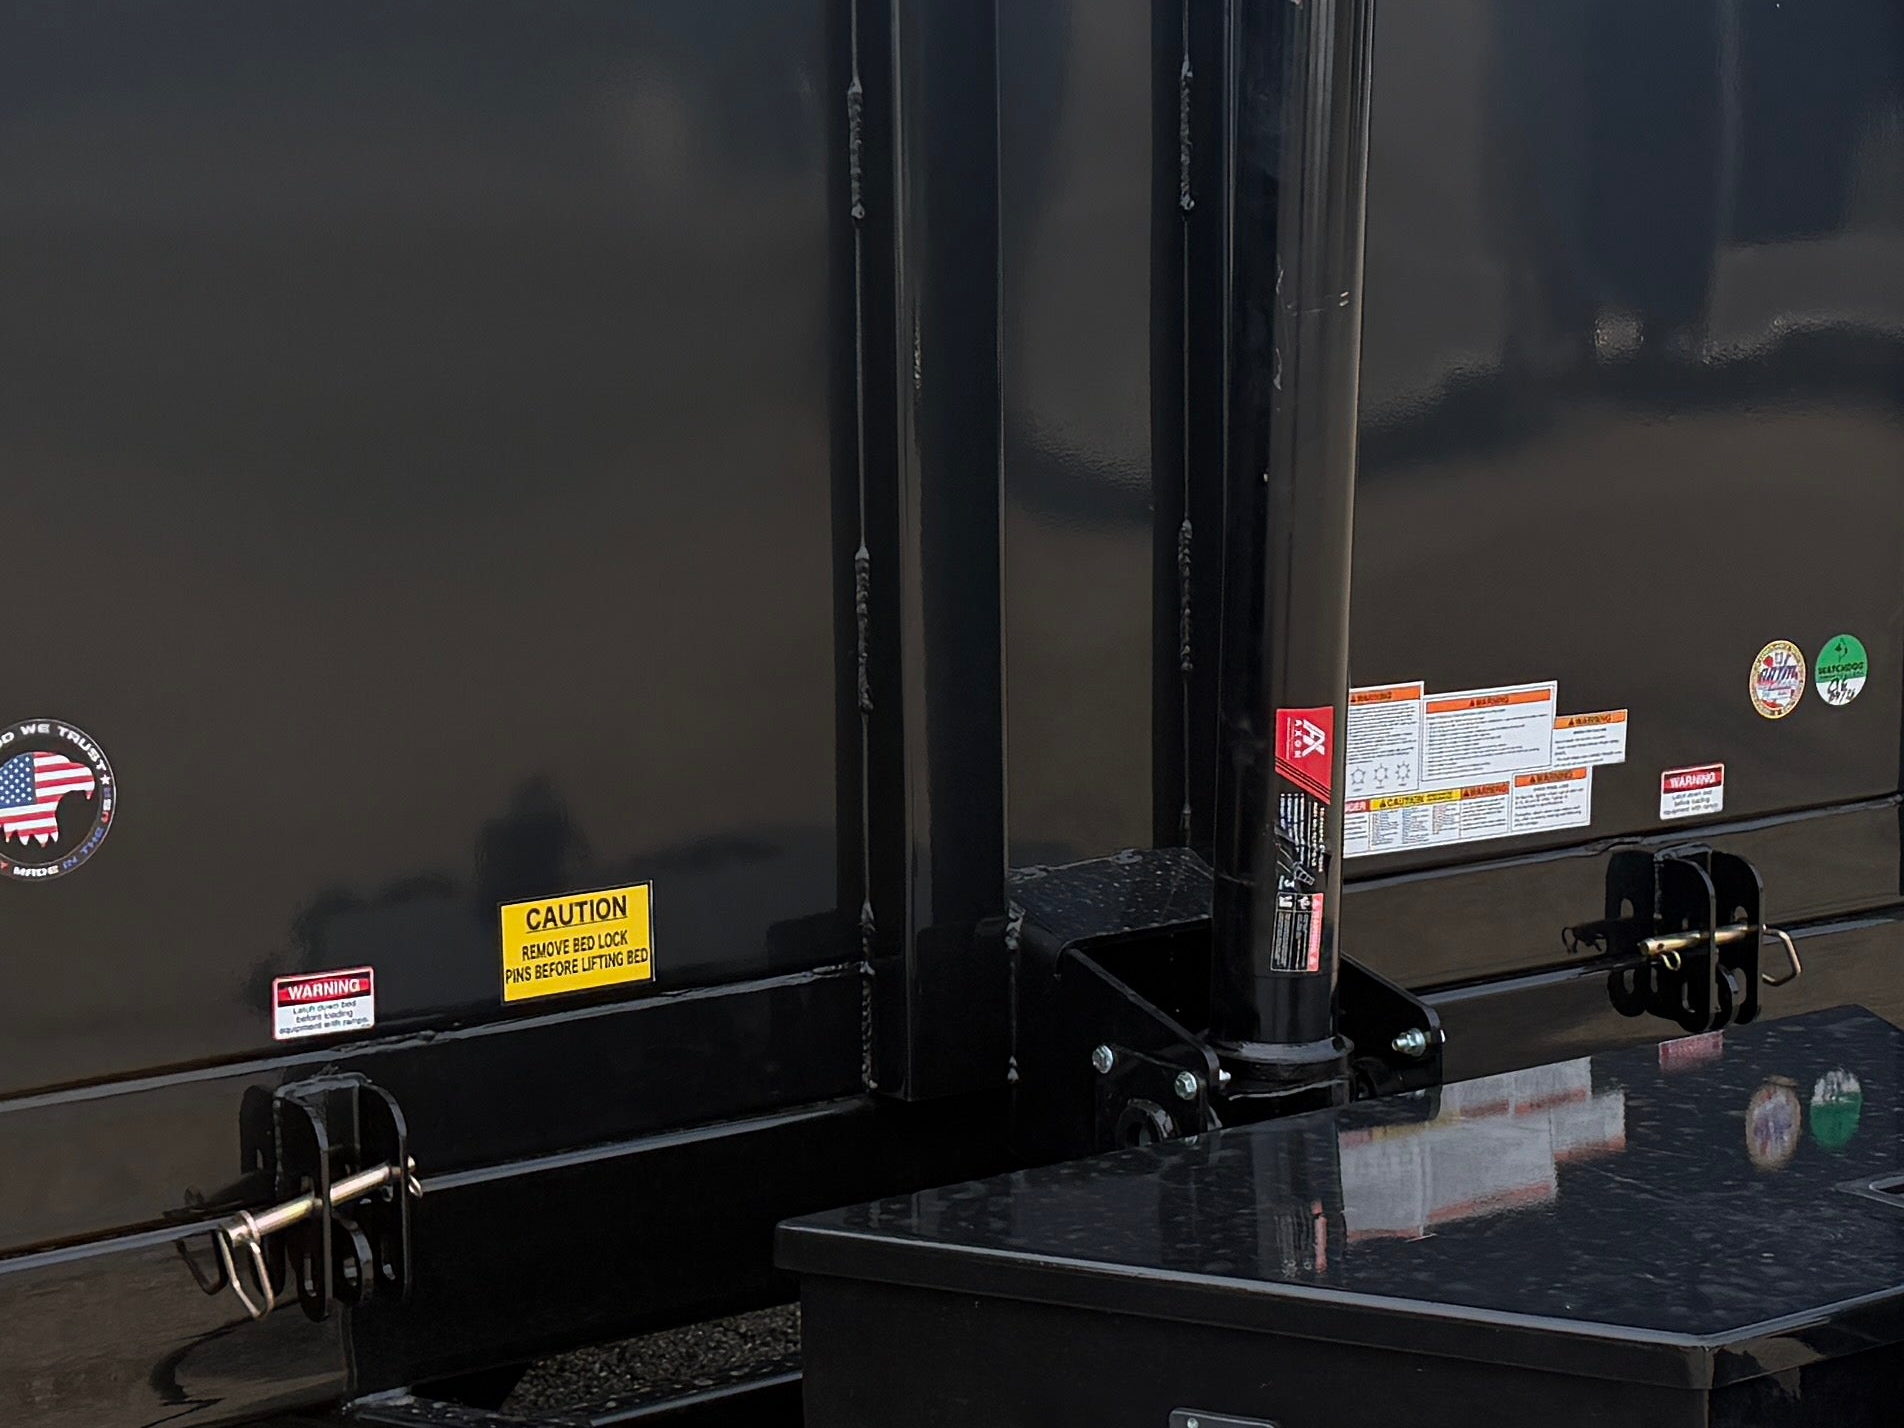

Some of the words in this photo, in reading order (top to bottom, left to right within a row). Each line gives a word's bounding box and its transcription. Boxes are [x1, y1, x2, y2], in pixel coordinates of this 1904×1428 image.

[1818, 662, 1864, 674] WATCHDOG
[20, 723, 51, 735] WE
[57, 725, 107, 771] TRUST
[1294, 719, 1303, 759] AXON
[1670, 772, 1716, 789] WARNING
[13, 865, 60, 877] MADE
[63, 856, 79, 869] IN
[526, 895, 627, 930] CAUTION
[522, 939, 570, 961] REMOVE
[573, 936, 595, 953] BED
[598, 930, 628, 949] LOCK
[505, 967, 532, 985] PINS
[535, 959, 578, 980] BEFORE
[582, 952, 624, 972] LIFTING
[627, 948, 648, 965] BED
[287, 978, 360, 1000] WARNING
[293, 1006, 315, 1014] Latch
[317, 1003, 339, 1012] down
[341, 1000, 356, 1008] bed
[296, 1014, 322, 1023] before
[324, 1010, 353, 1019] loading
[279, 1022, 322, 1034] equipment
[324, 1020, 341, 1028] with
